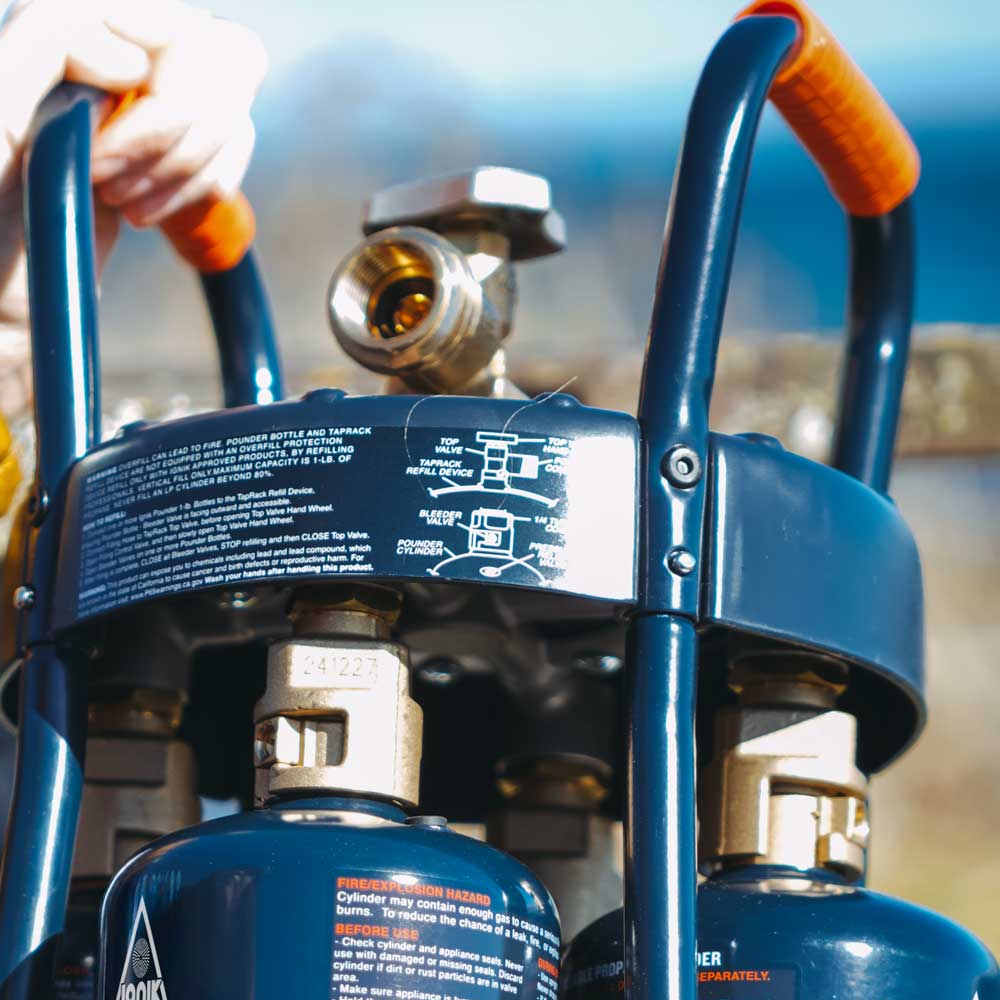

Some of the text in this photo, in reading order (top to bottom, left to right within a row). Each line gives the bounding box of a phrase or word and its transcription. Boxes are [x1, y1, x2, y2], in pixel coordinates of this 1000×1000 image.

[226, 434, 268, 445] POUNDER
[270, 431, 304, 440] BOTTLE
[240, 437, 342, 452] OVERFILL PROTECTION
[307, 446, 354, 454] REFILLING
[420, 459, 462, 468] TAPRACK
[443, 468, 474, 477] DEVICE
[217, 473, 251, 484] BEYOND
[419, 510, 462, 519] BLEEDER
[427, 518, 454, 526] VALVE
[398, 539, 443, 548] POUNDER
[397, 547, 443, 555] CYLINDER
[287, 565, 320, 574] handling
[340, 564, 374, 572] product.
[337, 877, 491, 907] FIRE/EXPLOSION HAZARD
[337, 891, 386, 906] Cylinder
[390, 895, 414, 908] may
[417, 895, 456, 912] contain
[458, 902, 493, 924] enough
[495, 913, 510, 928] gas
[512, 915, 519, 928] to
[337, 904, 504, 936] burns. To reduce the chance of
[335, 924, 418, 940] BEFORE USE
[342, 936, 523, 972] Check cylinder and appliance seals. Never
[340, 983, 368, 994] Make
[370, 986, 393, 996] sure
